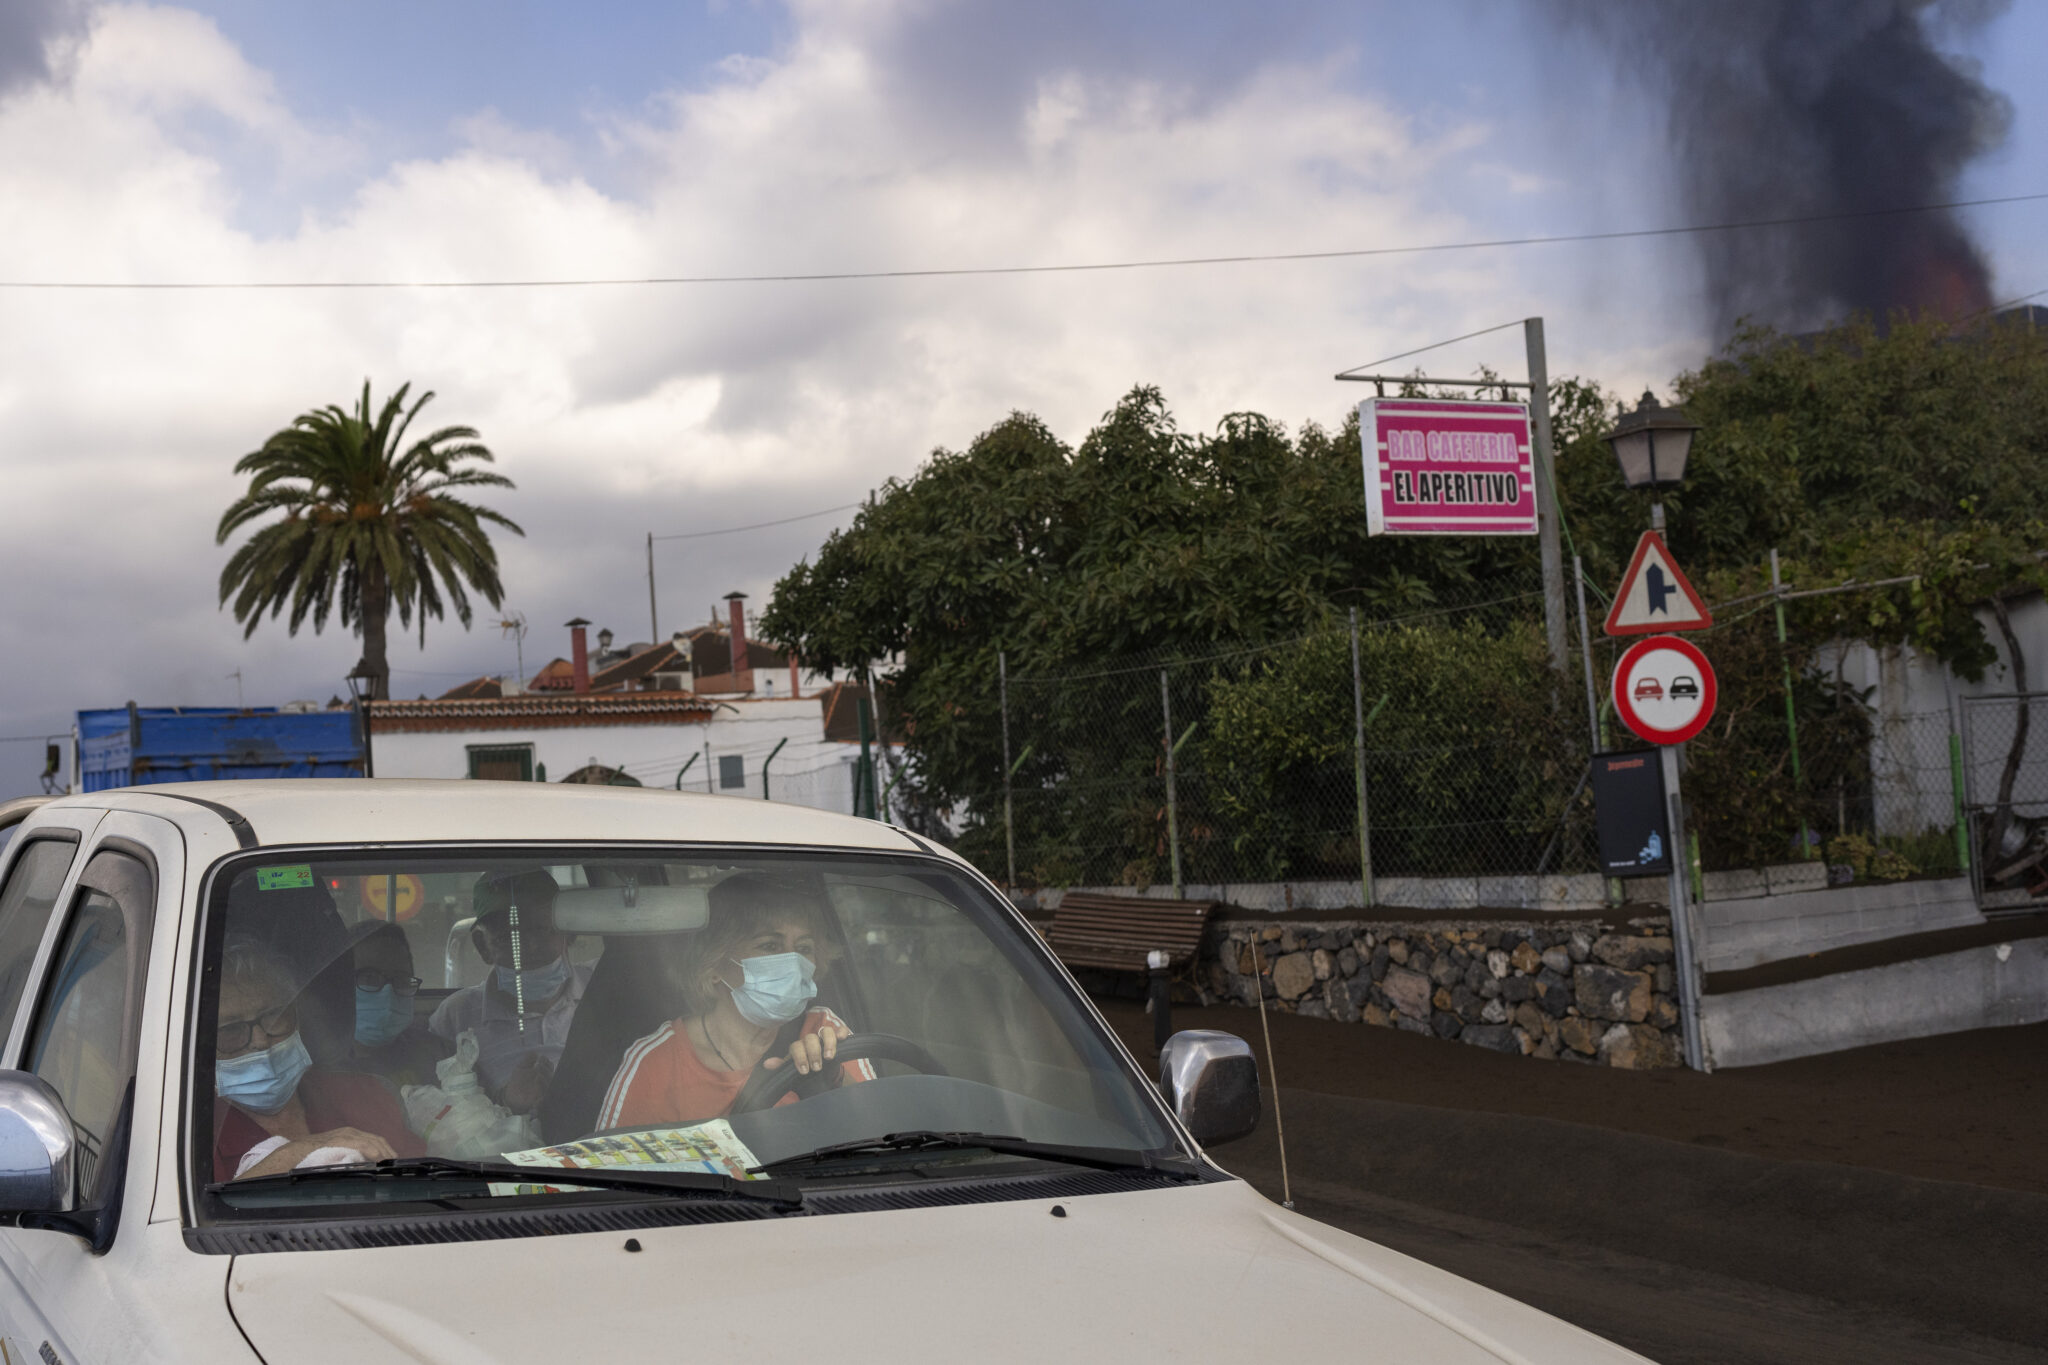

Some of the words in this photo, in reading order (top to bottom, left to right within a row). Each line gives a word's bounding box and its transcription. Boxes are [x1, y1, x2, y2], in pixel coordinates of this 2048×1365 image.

[1388, 430, 1426, 461] BAR
[1427, 430, 1519, 463] CAFETERIA
[1393, 471, 1416, 503] EL
[1418, 472, 1518, 504] APERITIVO
